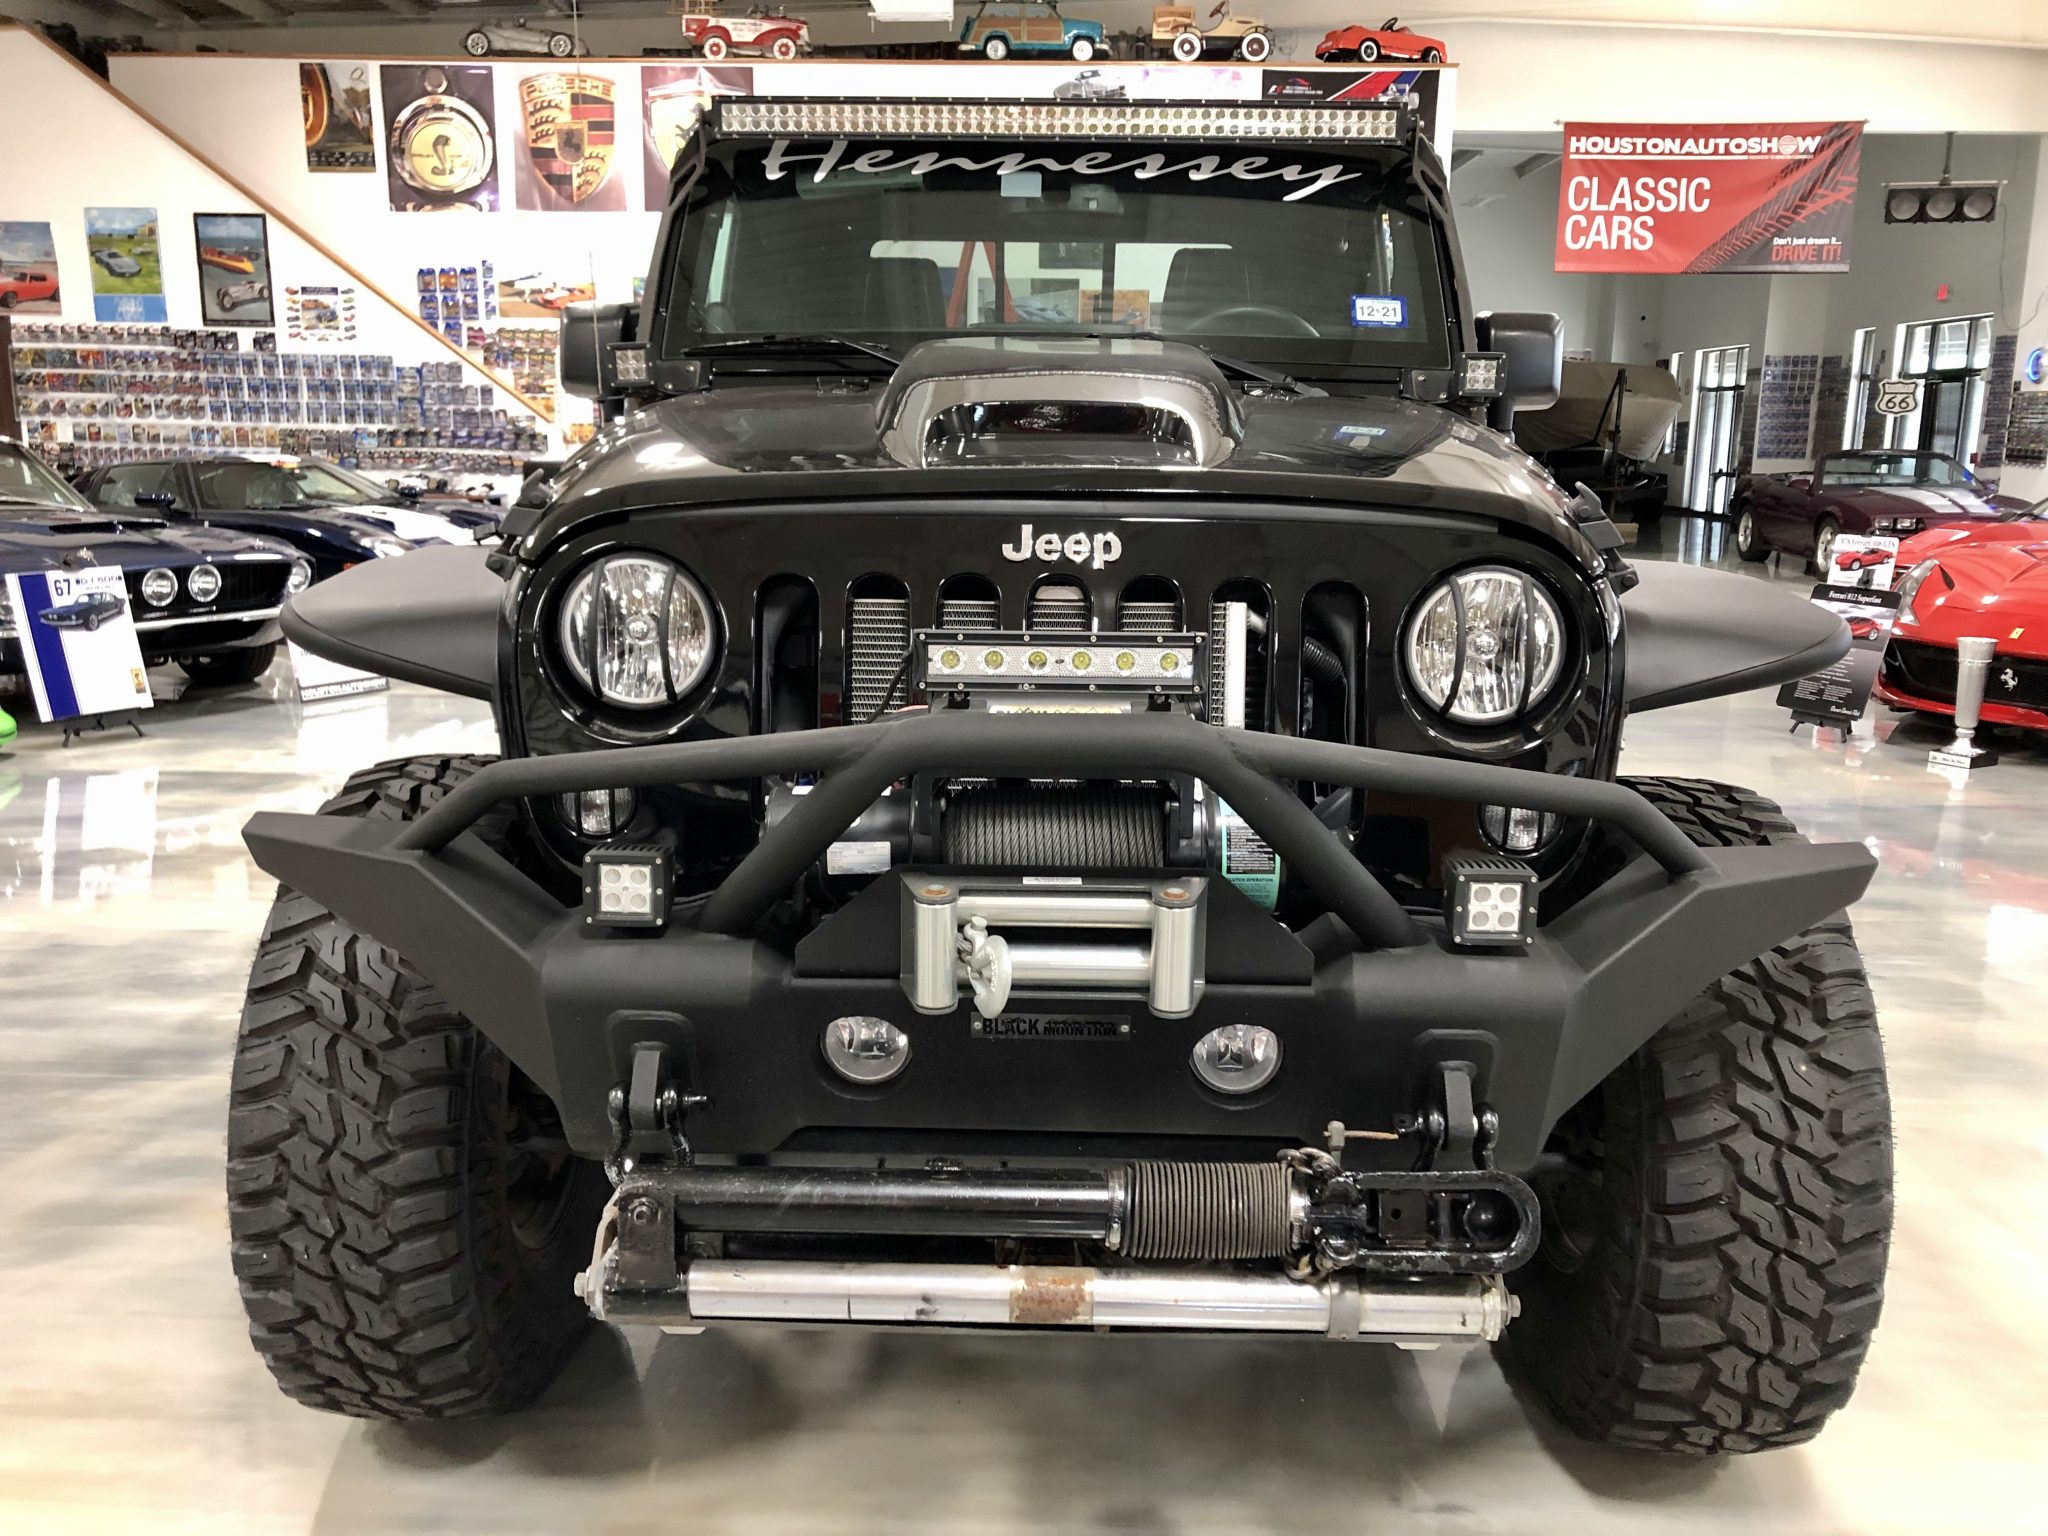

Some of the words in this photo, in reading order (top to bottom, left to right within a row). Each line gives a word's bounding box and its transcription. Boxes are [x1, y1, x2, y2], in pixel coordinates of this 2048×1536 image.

[762, 139, 1362, 201] Hennessey
[1567, 175, 1711, 213] CLASSIC
[1564, 215, 1655, 250] CARS
[1773, 236, 1792, 245] Don't
[1792, 236, 1807, 246] just
[1807, 236, 1830, 245] dream
[1772, 245, 1818, 261] DRIVE
[1822, 245, 1843, 261] IT!
[1359, 305, 1375, 317] 12
[1381, 306, 1397, 318] 21
[1885, 395, 1910, 410] 66
[1002, 523, 1122, 571] Jeep
[53, 578, 71, 597] 67
[1828, 590, 1847, 599] Ferrari
[1857, 593, 1882, 604] Superfast
[982, 1018, 1040, 1036] BLACK
